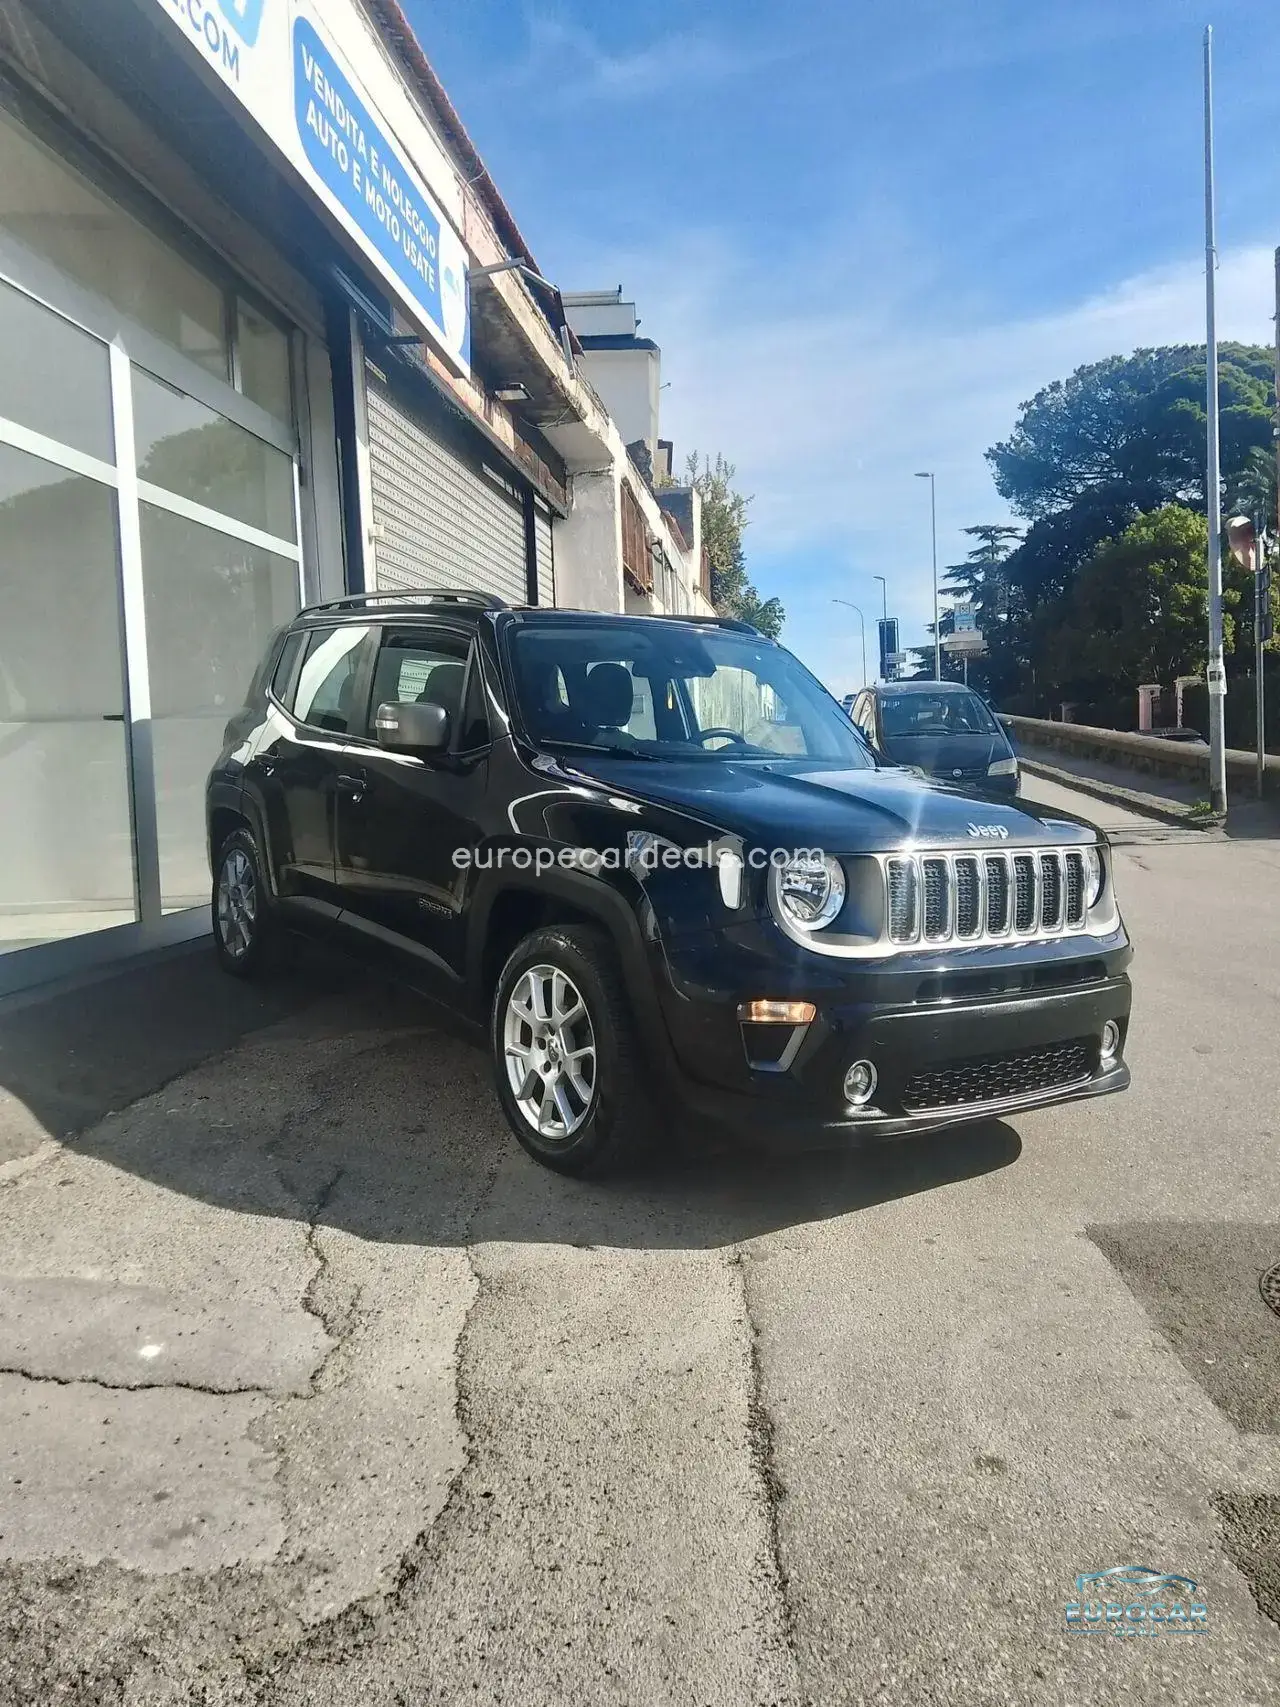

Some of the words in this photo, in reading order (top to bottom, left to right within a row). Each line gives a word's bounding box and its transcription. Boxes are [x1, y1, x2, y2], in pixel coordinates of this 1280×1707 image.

[172, 0, 240, 83] .COM
[301, 42, 368, 163] VENDITA
[370, 146, 380, 179] E
[382, 163, 436, 259] NOLEGGIO
[306, 98, 349, 173] AUTO
[352, 158, 362, 194] E
[365, 176, 401, 243] MOTO
[402, 228, 436, 293] USATE
[967, 821, 1009, 840] Jeep
